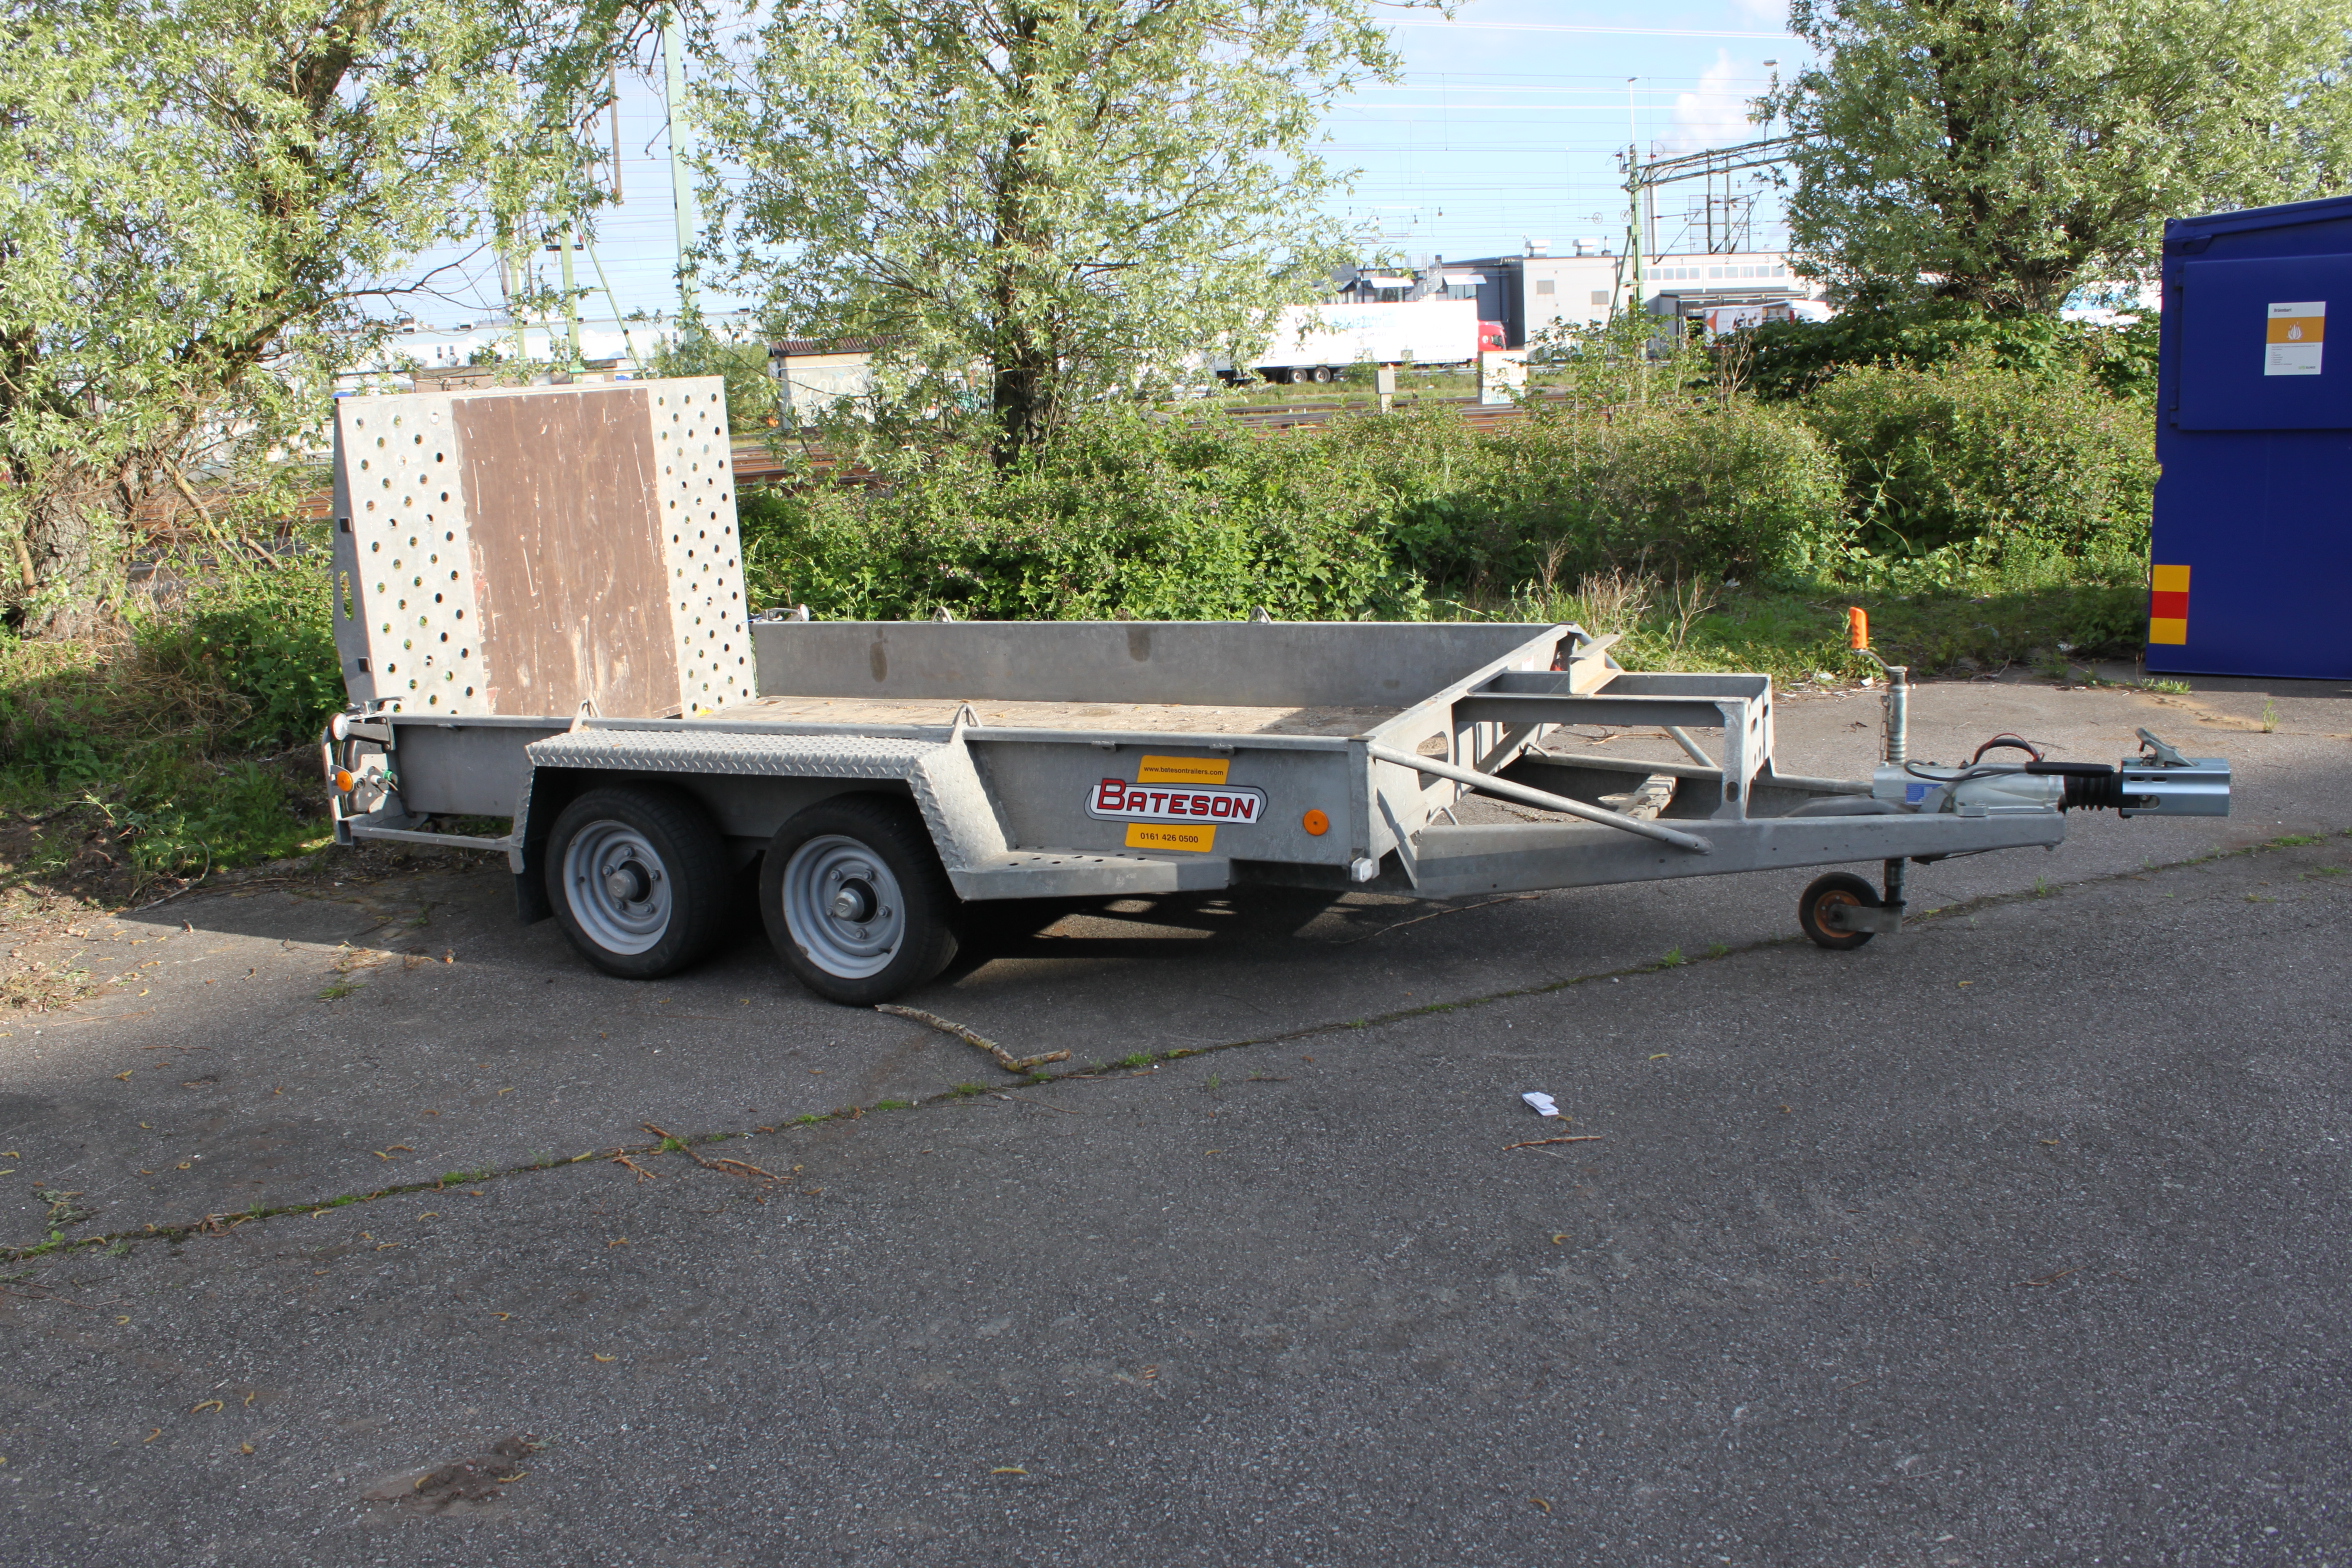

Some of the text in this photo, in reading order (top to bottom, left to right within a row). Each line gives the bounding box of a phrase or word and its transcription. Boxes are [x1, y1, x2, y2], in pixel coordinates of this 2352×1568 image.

[1724, 256, 1730, 265] 2
[1764, 255, 1770, 264] 3
[1143, 766, 1224, 776] www.batesontrailers.com
[1097, 778, 1255, 819] BATESON
[1140, 832, 1199, 844] 0161 426 0500
